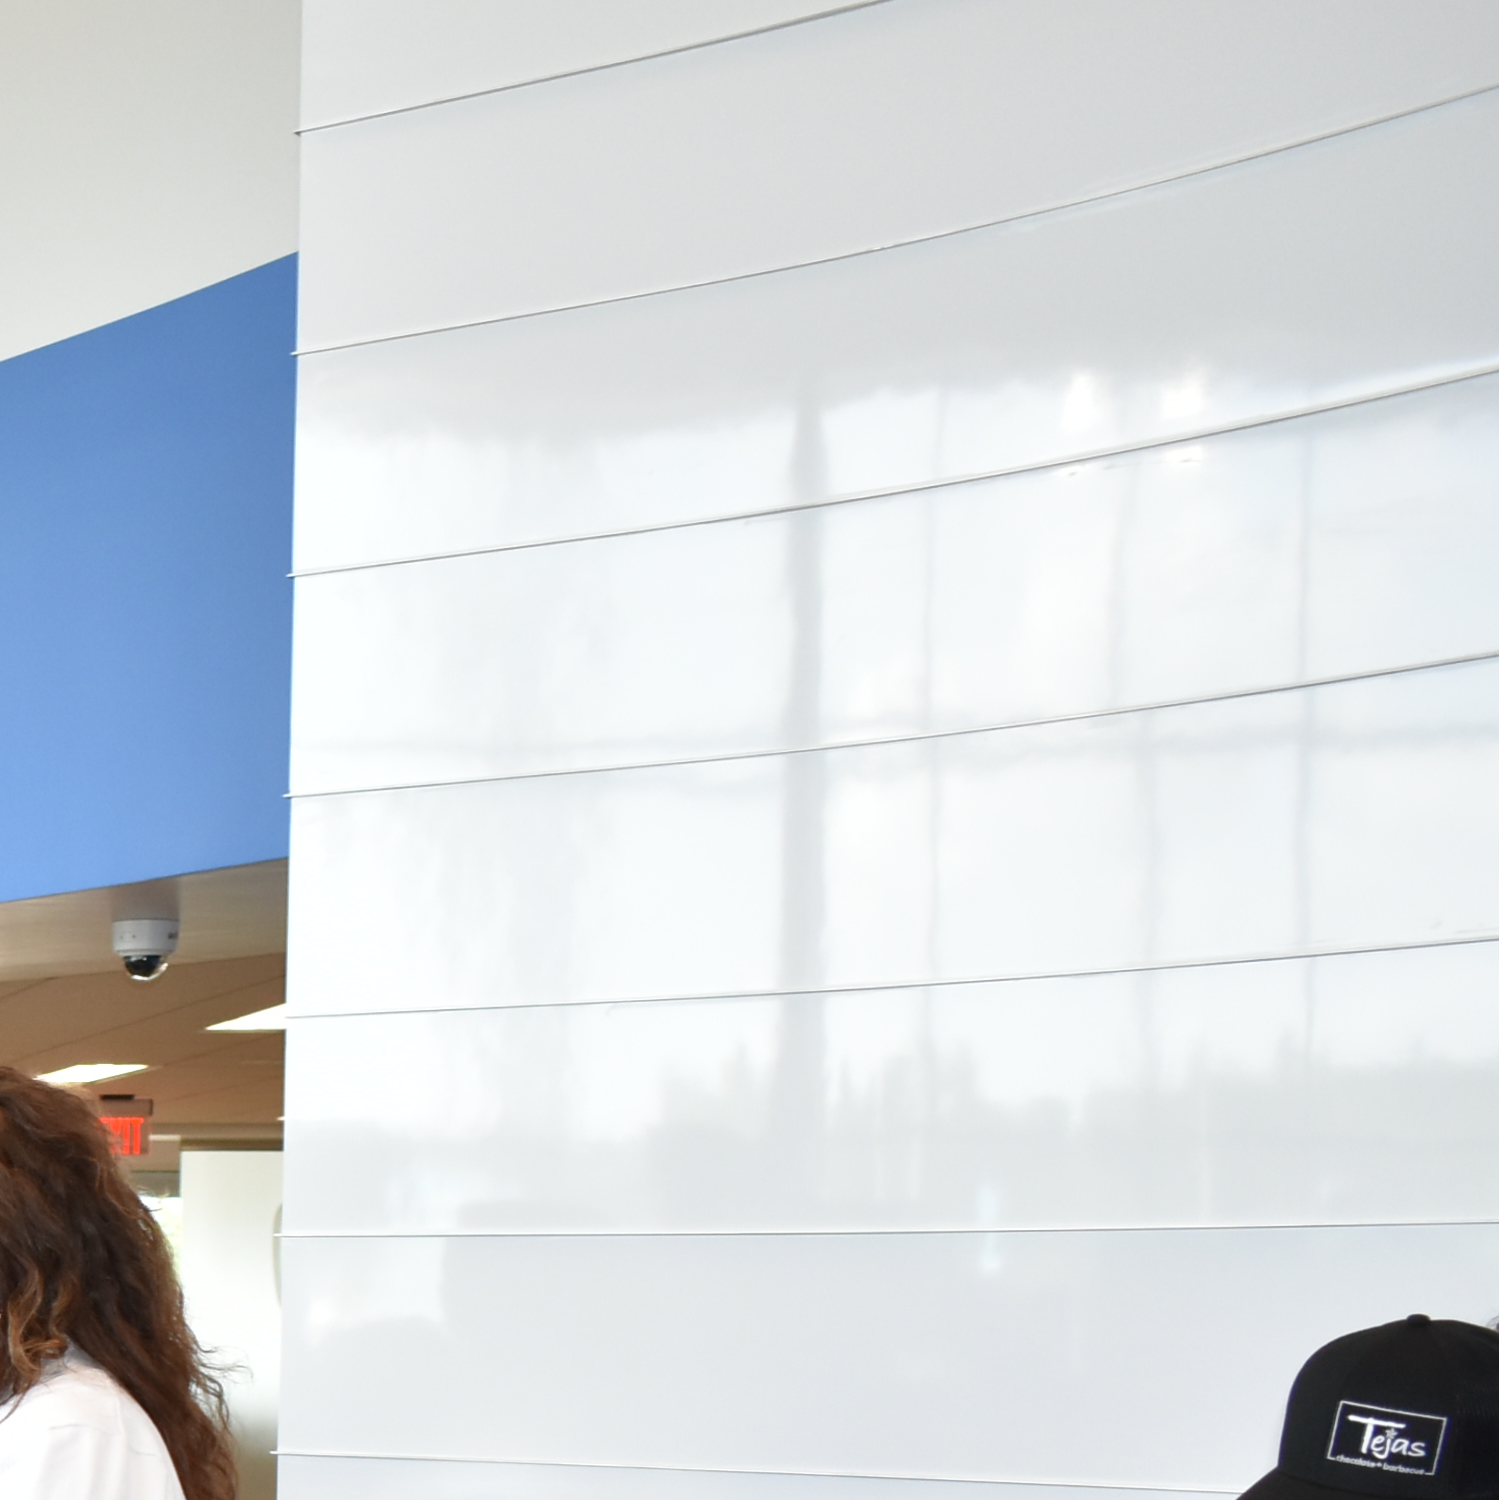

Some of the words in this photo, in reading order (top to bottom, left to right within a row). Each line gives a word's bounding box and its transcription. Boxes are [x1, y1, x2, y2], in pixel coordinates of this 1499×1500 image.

[100, 1116, 145, 1155] XIT
[1347, 1414, 1426, 1460] Tejas
[1335, 1453, 1376, 1469] chocolate
[1383, 1462, 1426, 1475] barbecue
